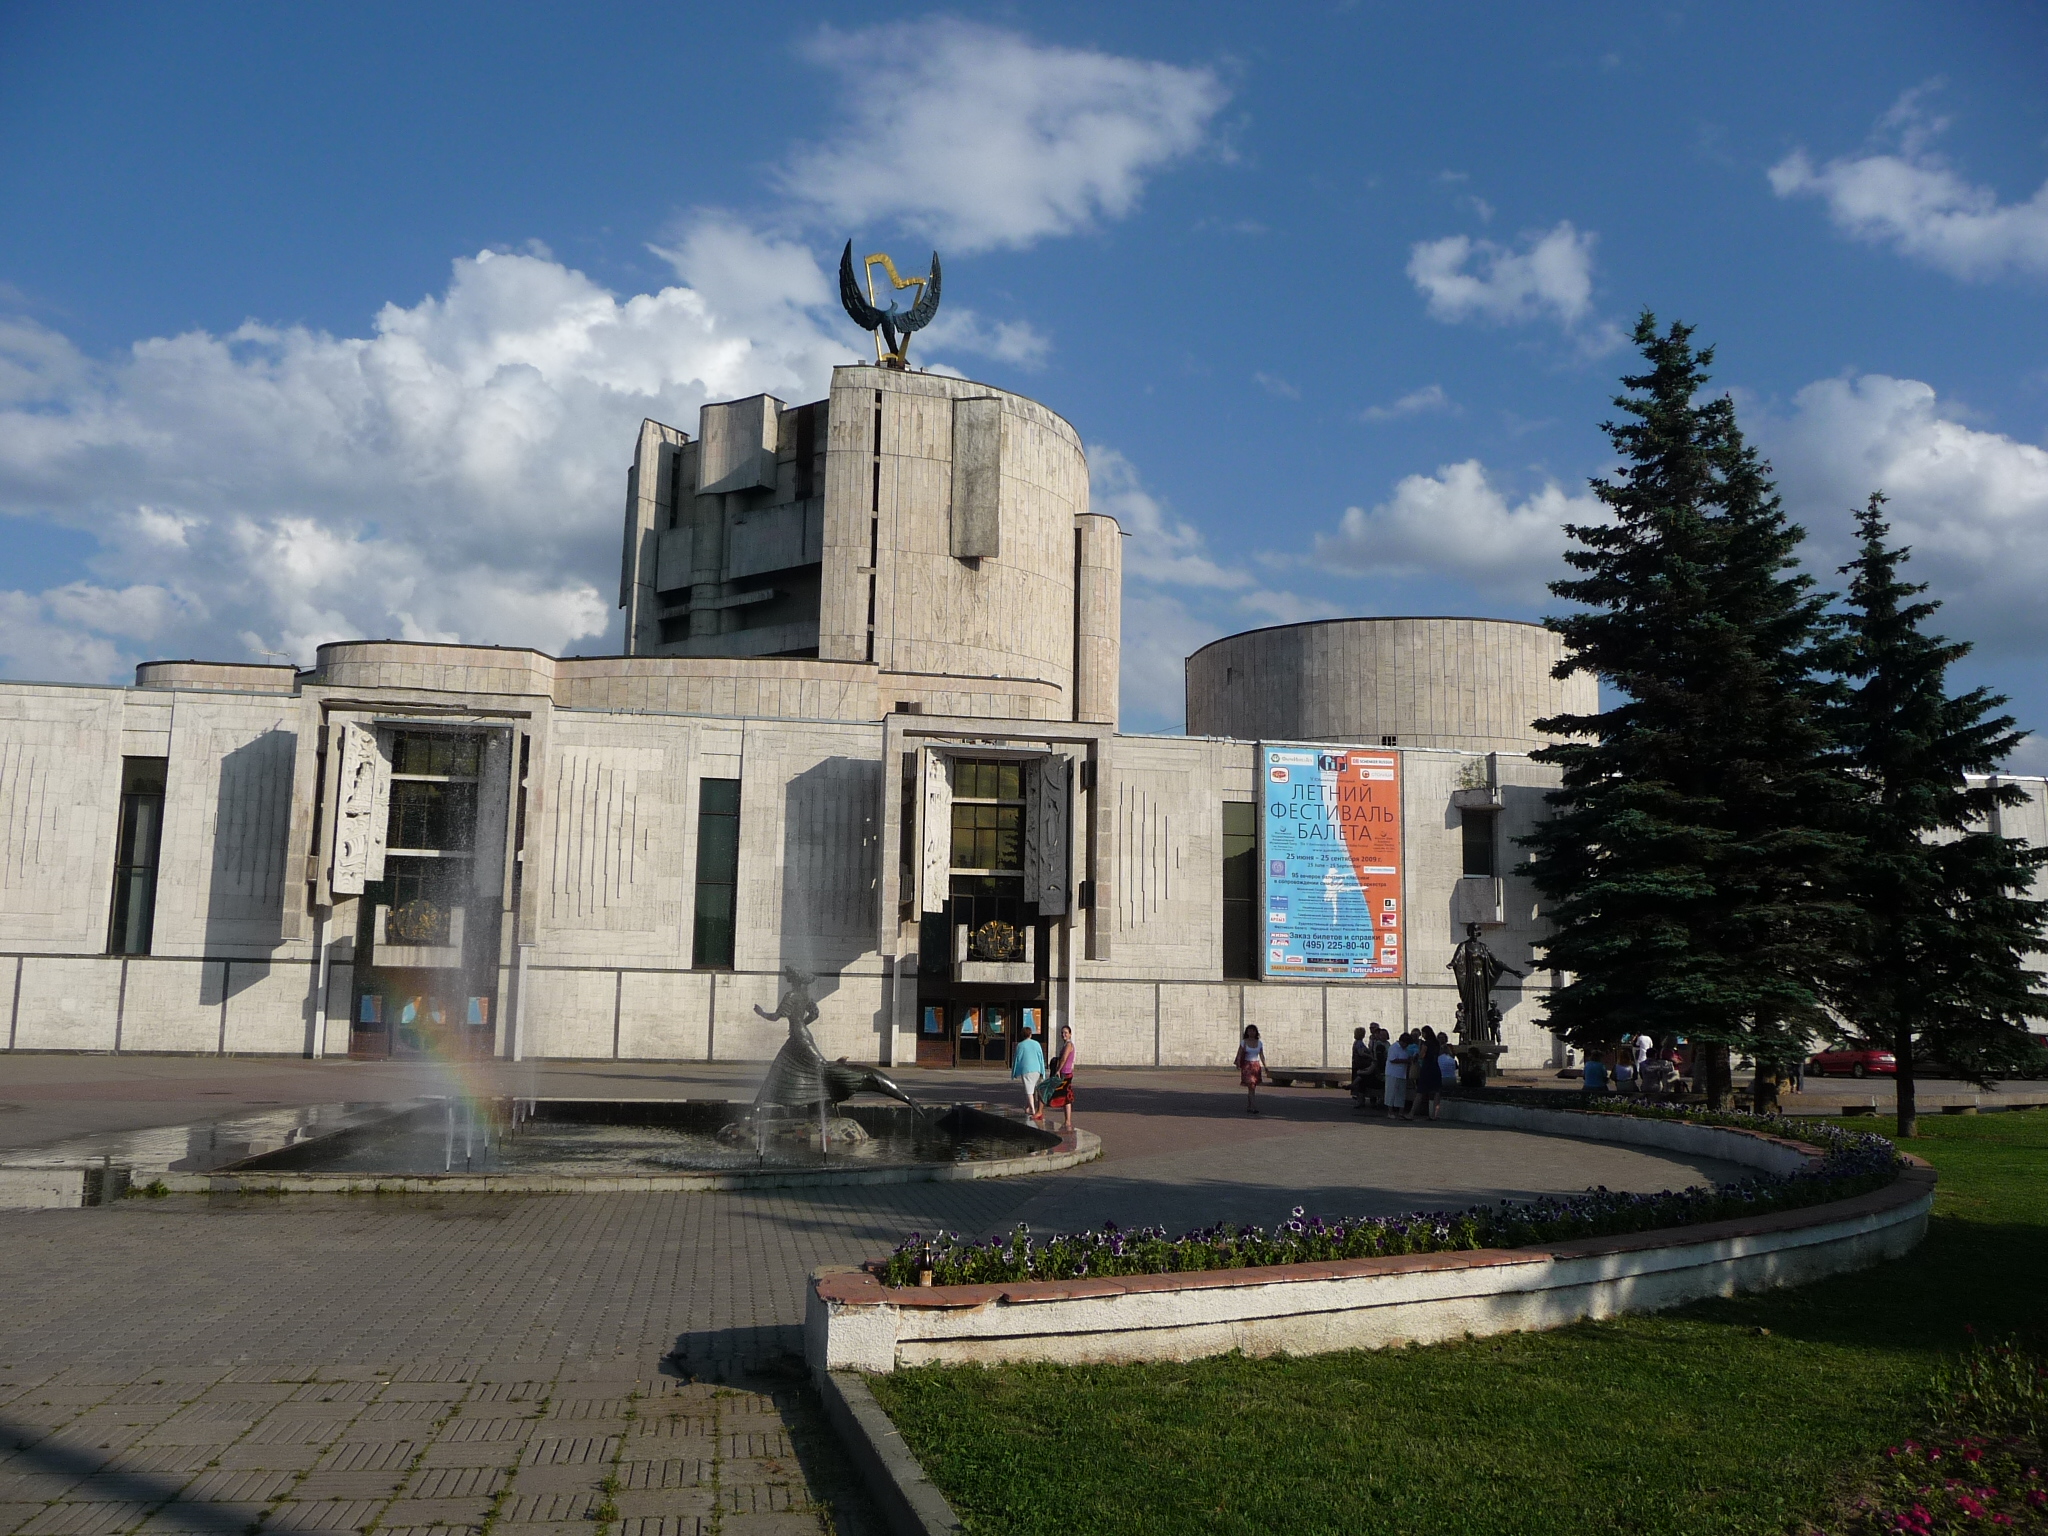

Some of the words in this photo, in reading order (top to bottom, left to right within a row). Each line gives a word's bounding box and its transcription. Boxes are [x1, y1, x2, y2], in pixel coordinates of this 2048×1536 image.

[1291, 783, 1372, 803] ЛЕТНИЙ
[1270, 801, 1394, 823] ФЕСТИВАЛЬ
[1298, 822, 1372, 841] БАЛЕТА
[1331, 855, 1359, 863] сентября
[1302, 940, 1325, 950] (495)
[1327, 941, 1370, 950] 225-80-40
